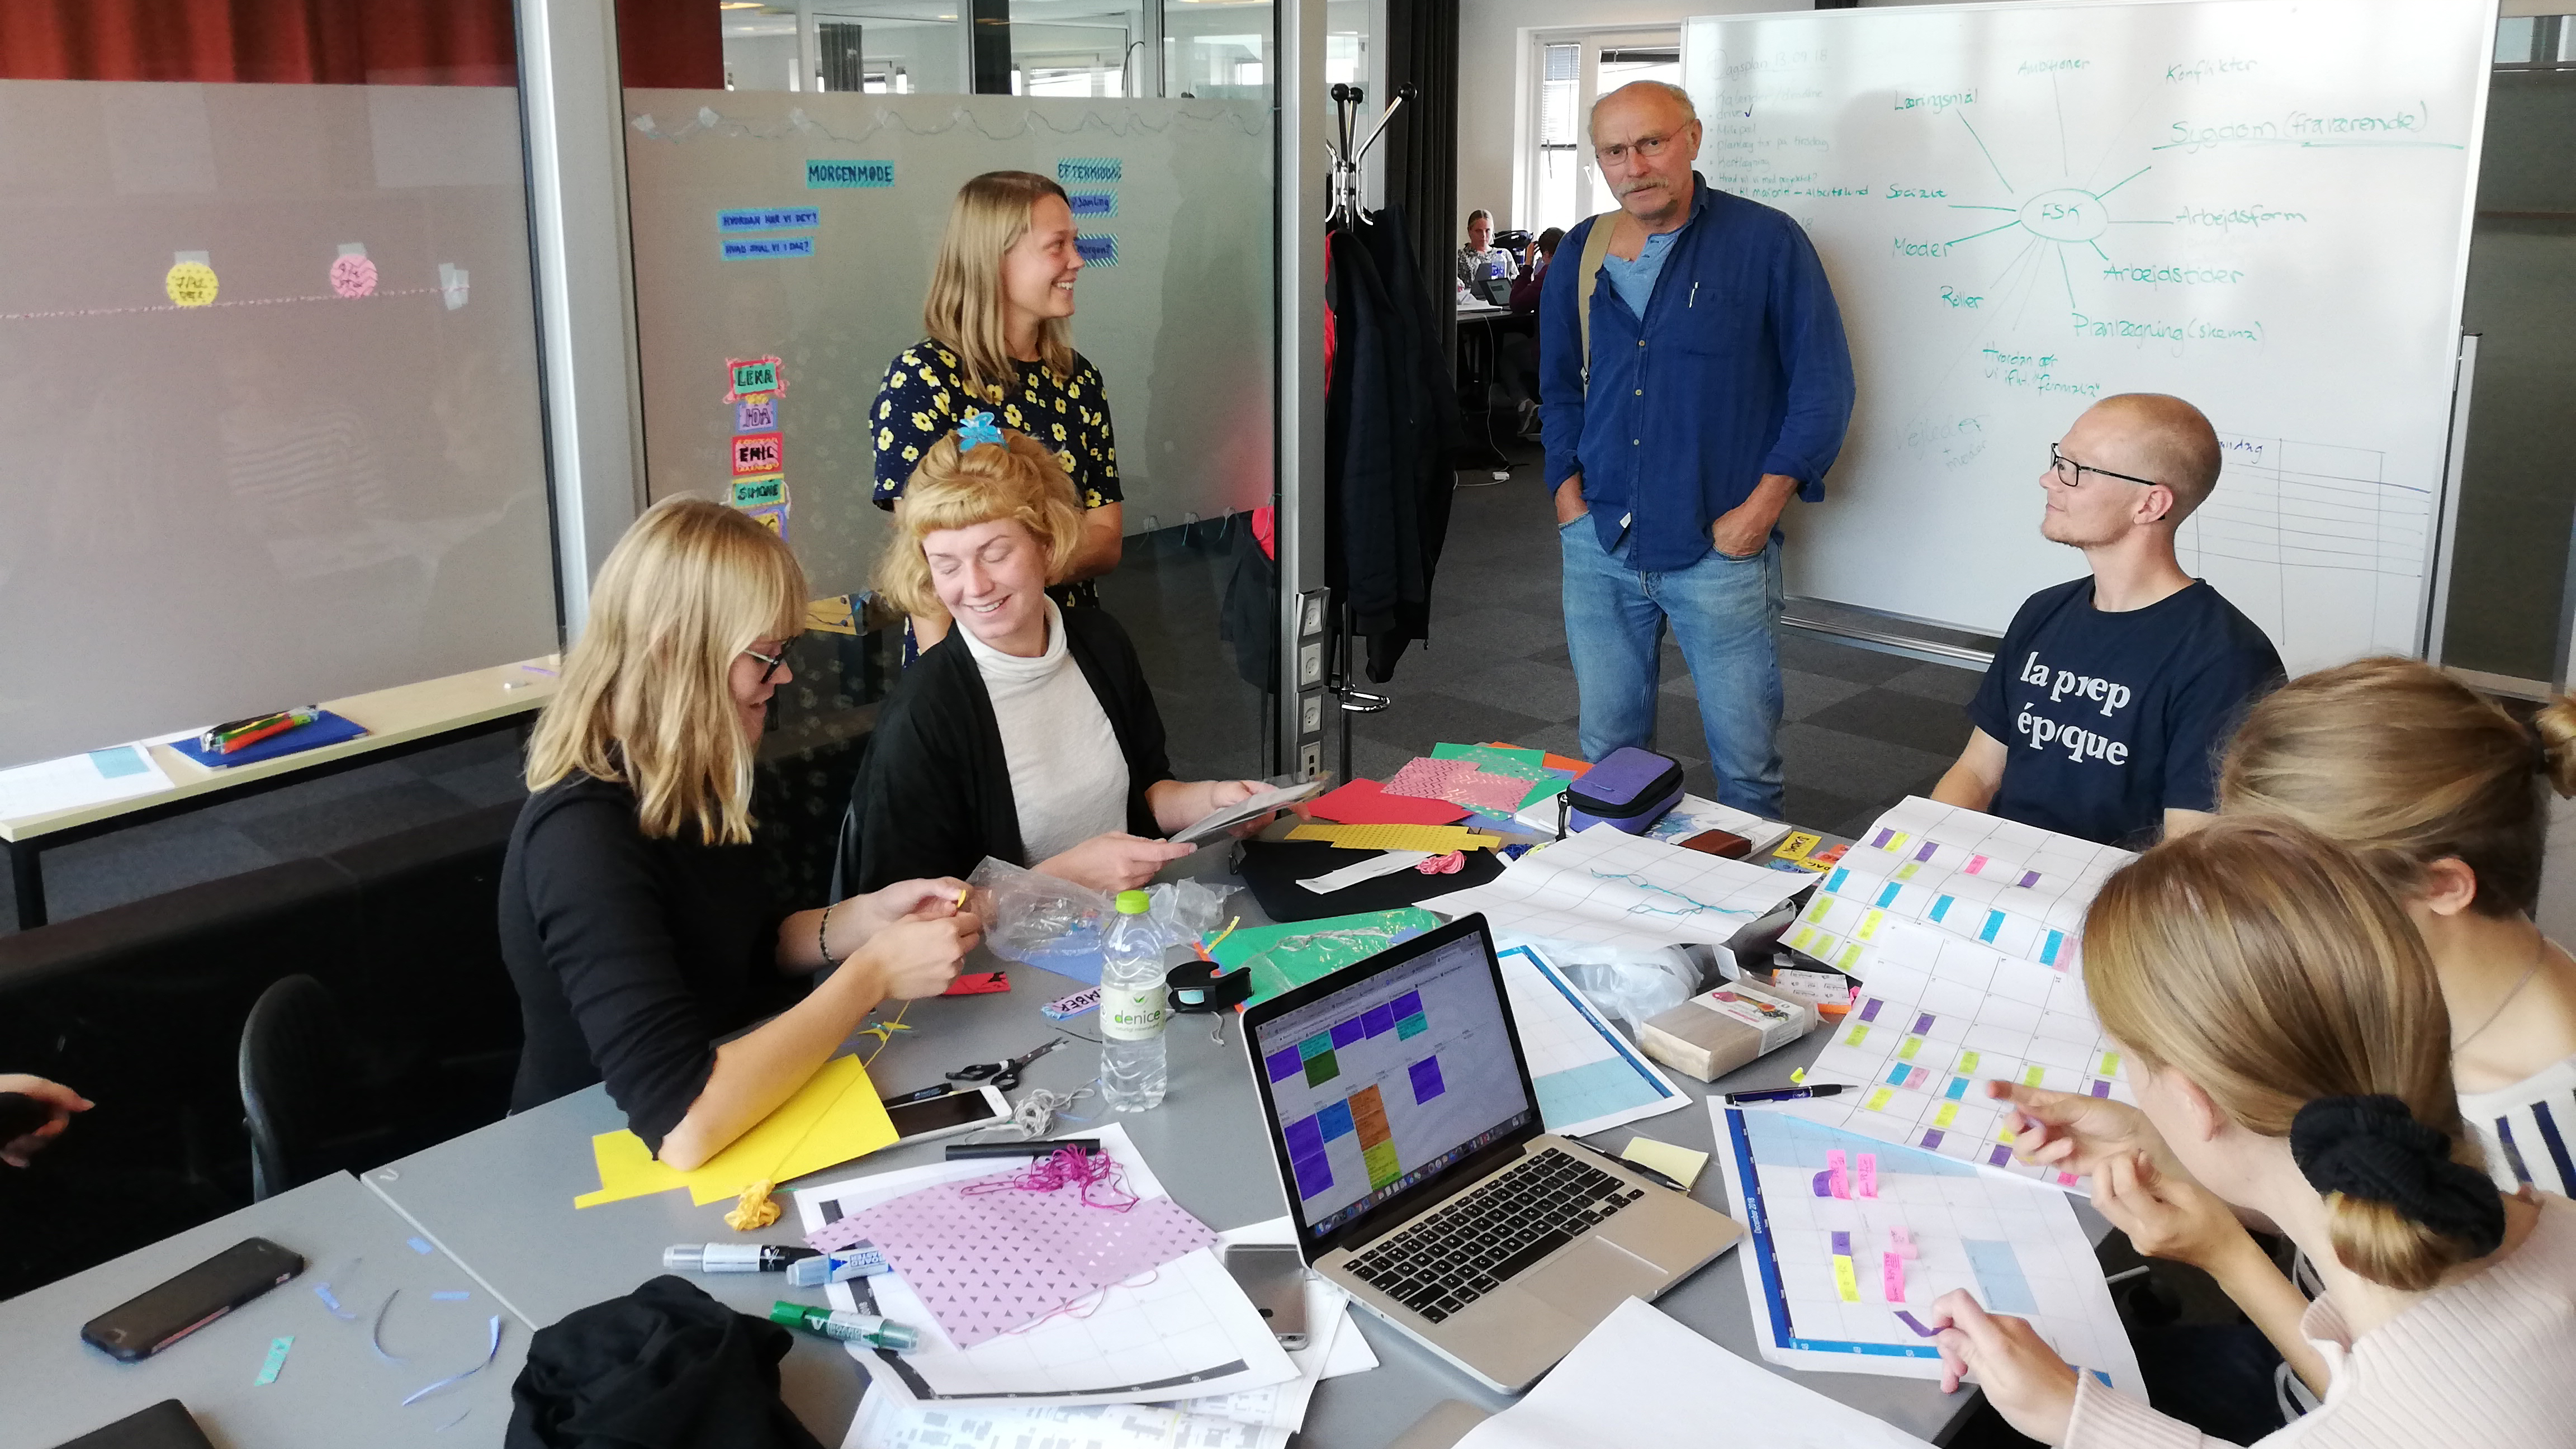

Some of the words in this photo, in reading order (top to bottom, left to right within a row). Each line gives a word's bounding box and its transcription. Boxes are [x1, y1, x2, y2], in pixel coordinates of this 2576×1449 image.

[2165, 58, 2258, 85] Konflikter
[2170, 119, 2277, 154] Sygdom
[2176, 204, 2308, 234] Arbejdsform
[2104, 263, 2244, 291] Arbejdstider
[1940, 285, 1984, 309] Roller
[740, 446, 775, 463] EMIL
[2020, 651, 2051, 687] la
[2050, 670, 2131, 717] prep
[2017, 702, 2129, 766] épique
[1115, 1010, 1161, 1025] denice
